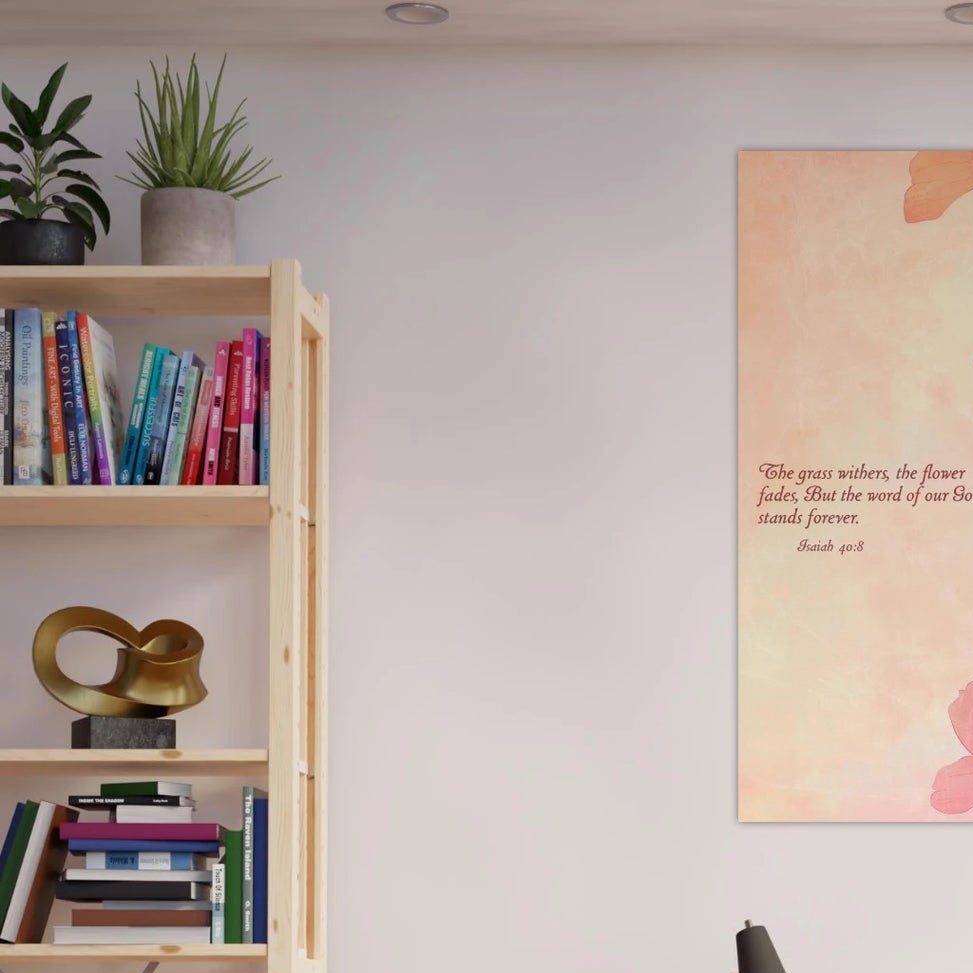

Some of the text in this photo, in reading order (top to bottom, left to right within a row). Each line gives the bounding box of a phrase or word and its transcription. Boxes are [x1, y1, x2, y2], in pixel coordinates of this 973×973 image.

[18, 325, 33, 386] Oil Paintings
[59, 344, 73, 408] ICONIC
[230, 363, 240, 396] Parenting
[75, 395, 83, 409] ART
[79, 440, 89, 472] NORMAN
[759, 463, 966, 485] The grass withers, the flower
[757, 486, 799, 507] fades,
[804, 485, 836, 502] But
[841, 486, 862, 502] the
[867, 486, 902, 502] word
[906, 486, 925, 507] of
[925, 491, 949, 502] our
[758, 507, 859, 529] stands forever.
[797, 538, 865, 555] Isaiah 40:8
[244, 850, 252, 880] Island
